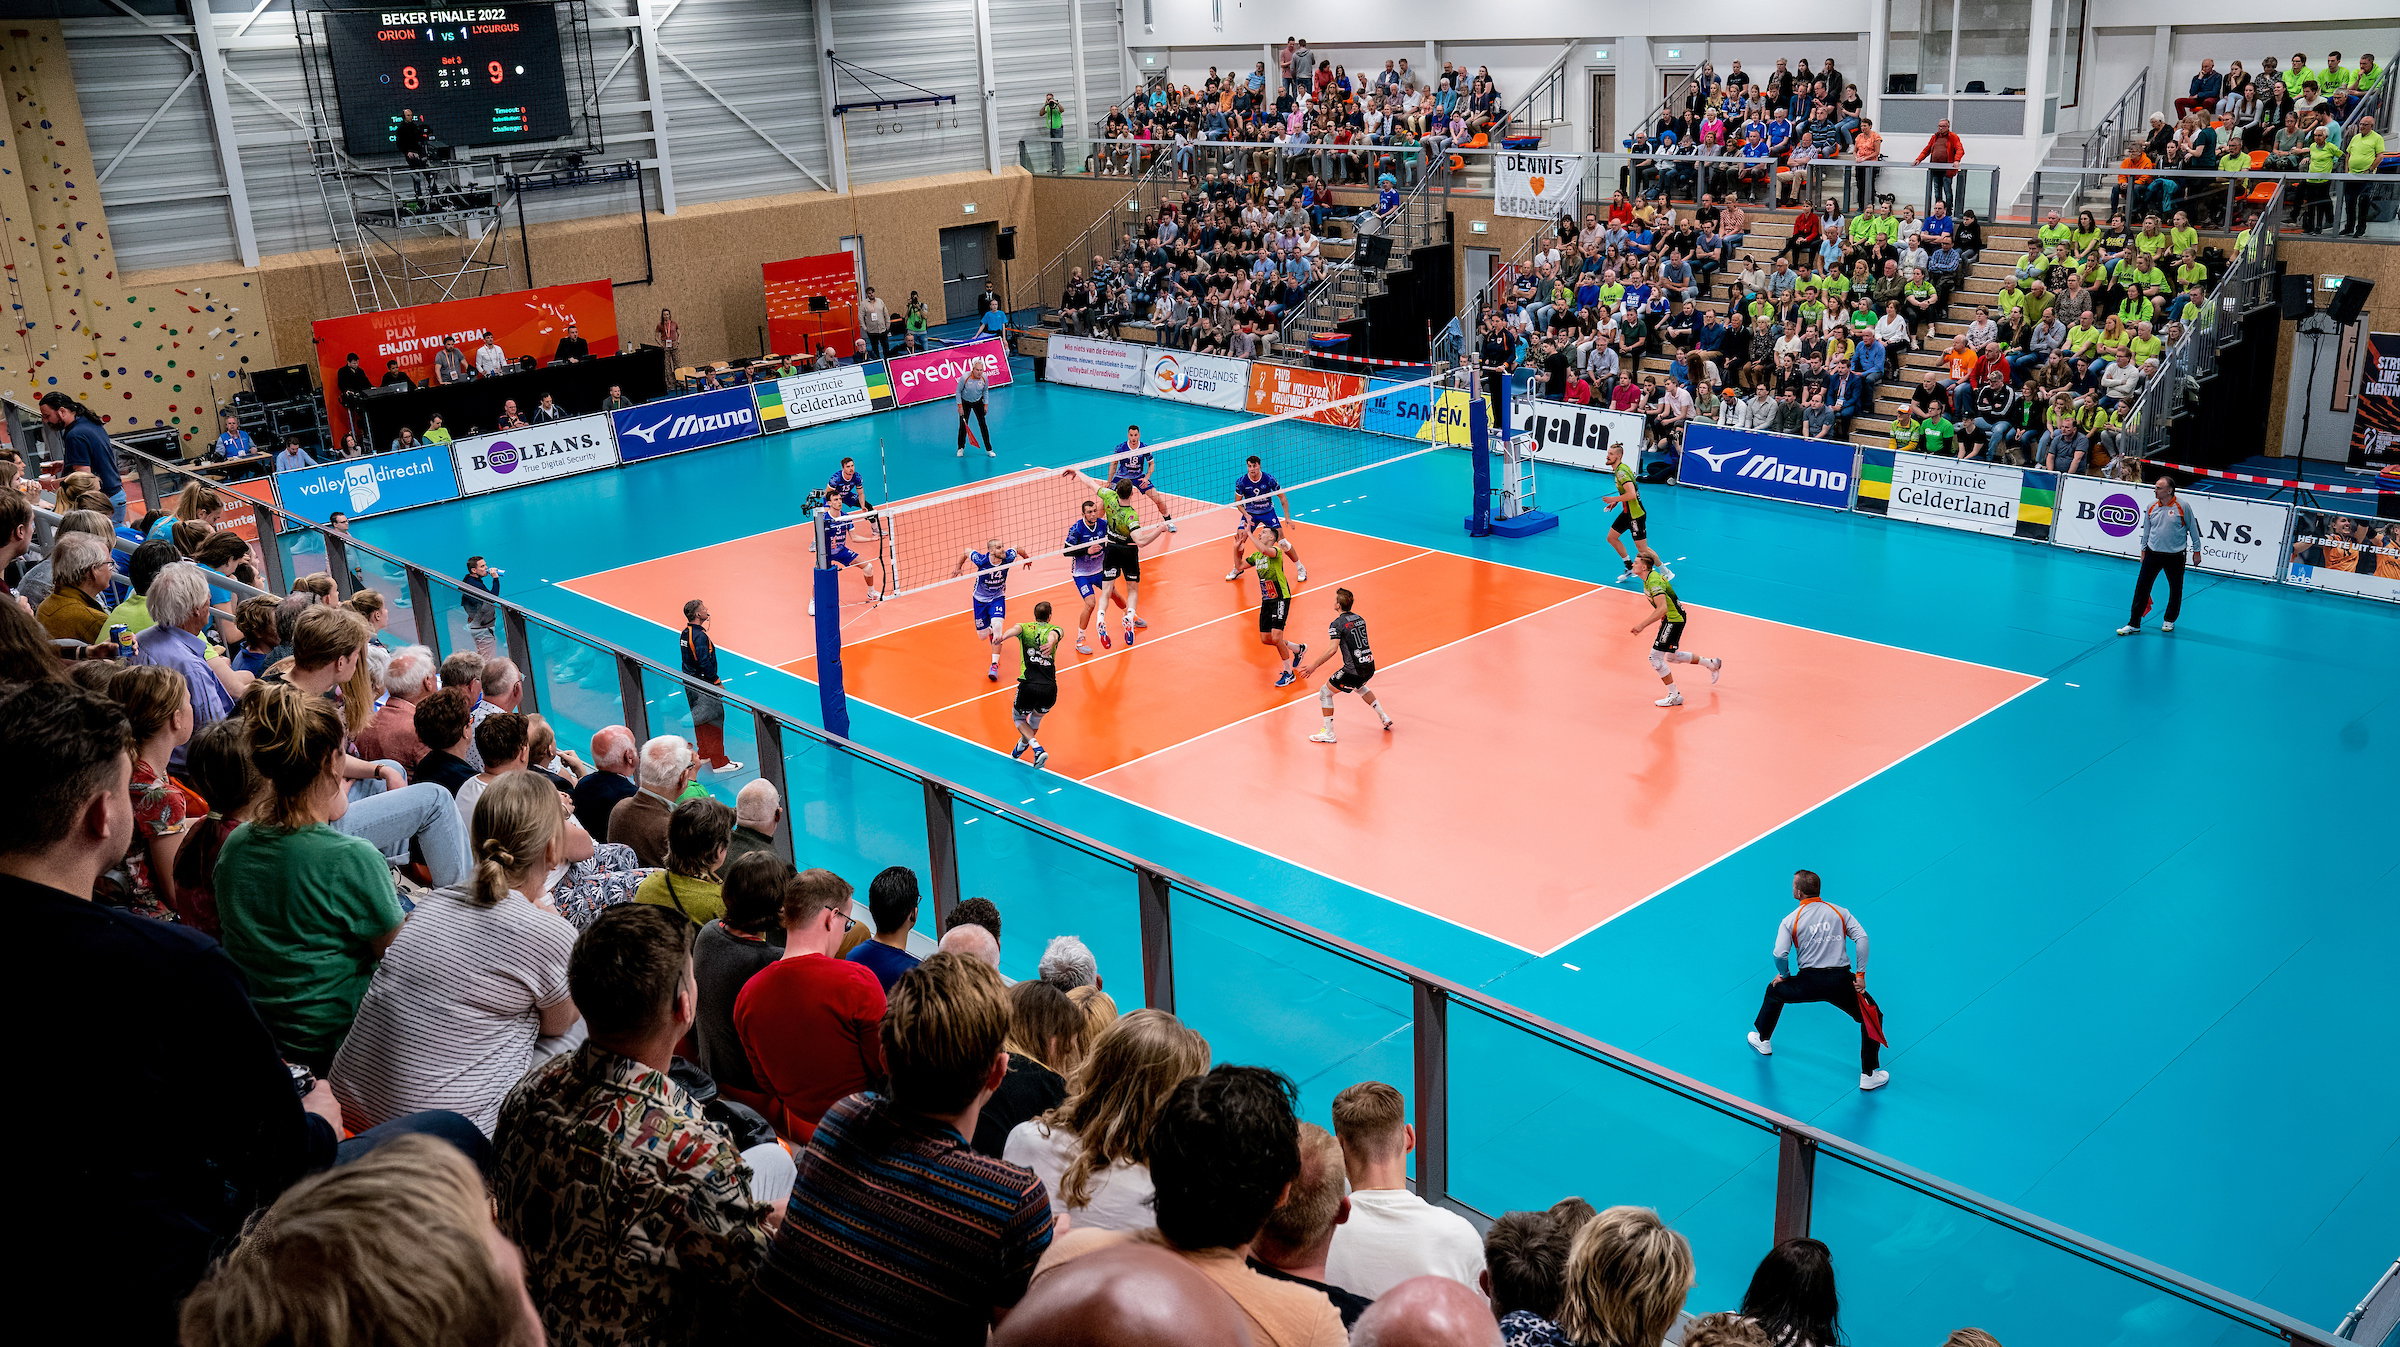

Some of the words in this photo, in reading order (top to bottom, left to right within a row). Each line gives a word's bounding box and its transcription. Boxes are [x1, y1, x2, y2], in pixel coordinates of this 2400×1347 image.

[381, 12, 428, 26] BEKER
[430, 10, 476, 24] FINALE
[478, 8, 506, 21] 2022
[377, 29, 416, 42] ORION
[426, 28, 434, 42] 1
[441, 32, 455, 42] VS
[460, 26, 468, 40] 1
[472, 23, 520, 34] LYCURGUS
[441, 57, 454, 65] Set
[456, 56, 463, 65] 3
[402, 66, 419, 90] 8
[438, 69, 448, 77] 25
[487, 60, 504, 84] 9
[461, 78, 471, 87] 25
[1507, 156, 1564, 175] DENNIS
[1500, 196, 1563, 217] BEDANK
[371, 313, 416, 330] WATCH
[385, 326, 417, 341] PLAY
[378, 339, 419, 356] ENJOY
[1102, 348, 1127, 358] Eredivisie
[1183, 366, 1239, 384] NEDERLANDSE
[2378, 370, 2400, 383] LIKE
[793, 377, 844, 399] provincie
[1292, 382, 1330, 400] VOLLEYBAL
[789, 388, 866, 417] Gelderland
[1271, 391, 1307, 408] VROUWEN
[667, 407, 753, 440] MIZUNO
[1524, 412, 1610, 453] gala
[523, 464, 540, 473] True
[541, 457, 566, 470] Digital
[567, 453, 597, 465] Security
[299, 457, 434, 496] volleybaldirect.nl
[1737, 454, 1847, 492] MIZUNO
[1910, 466, 1986, 491] provincie
[1253, 488, 1260, 497] 9
[1897, 487, 2010, 520] Gelderland
[2318, 537, 2351, 550] BESTE
[2351, 543, 2369, 552] UIT
[2202, 545, 2249, 563] Security
[1351, 626, 1369, 649] 15
